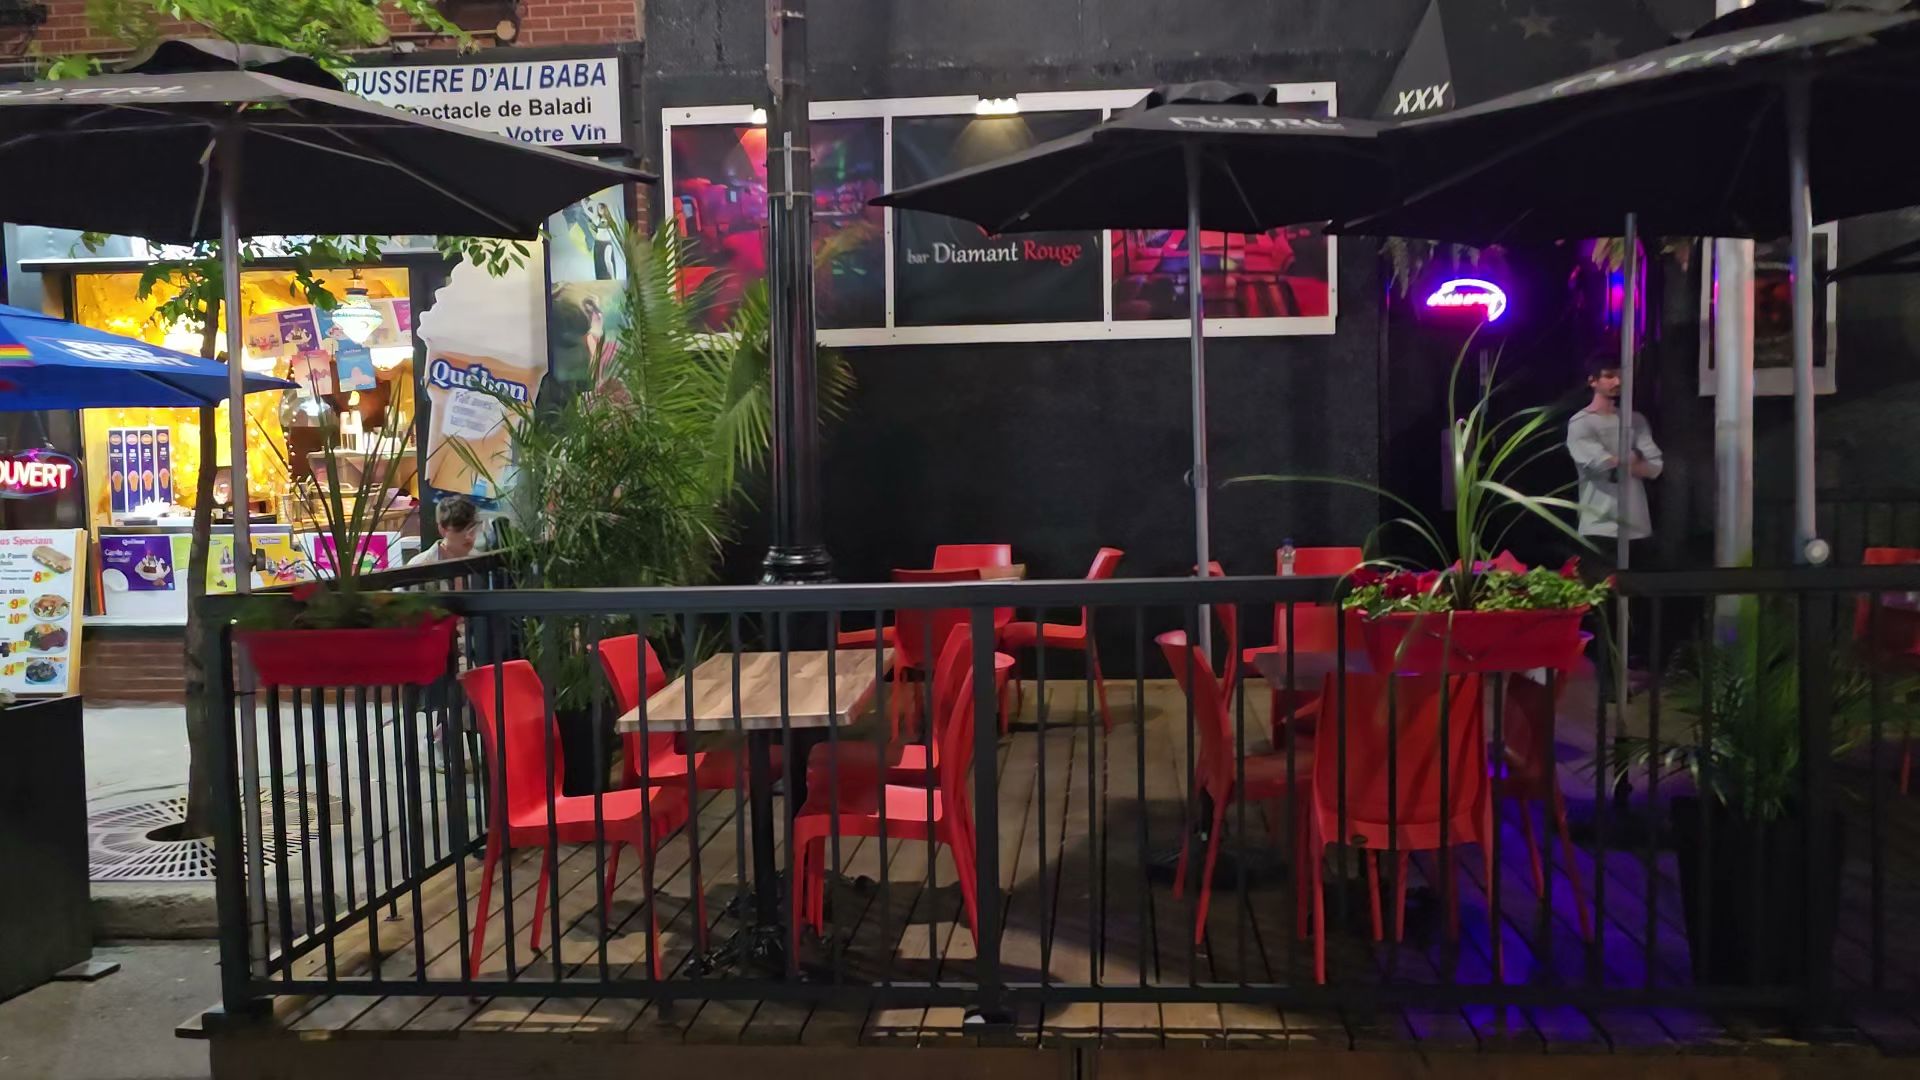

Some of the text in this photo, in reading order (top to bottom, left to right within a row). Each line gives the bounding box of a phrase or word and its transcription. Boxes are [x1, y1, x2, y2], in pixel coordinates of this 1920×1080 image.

[471, 66, 532, 92] D'ALI
[539, 62, 606, 89] BABA
[498, 101, 522, 118] de
[529, 97, 591, 116] Baladi
[1393, 81, 1450, 115] XXX
[506, 123, 607, 143] Votre Vin
[907, 239, 1082, 267] bar Diamant Rouge
